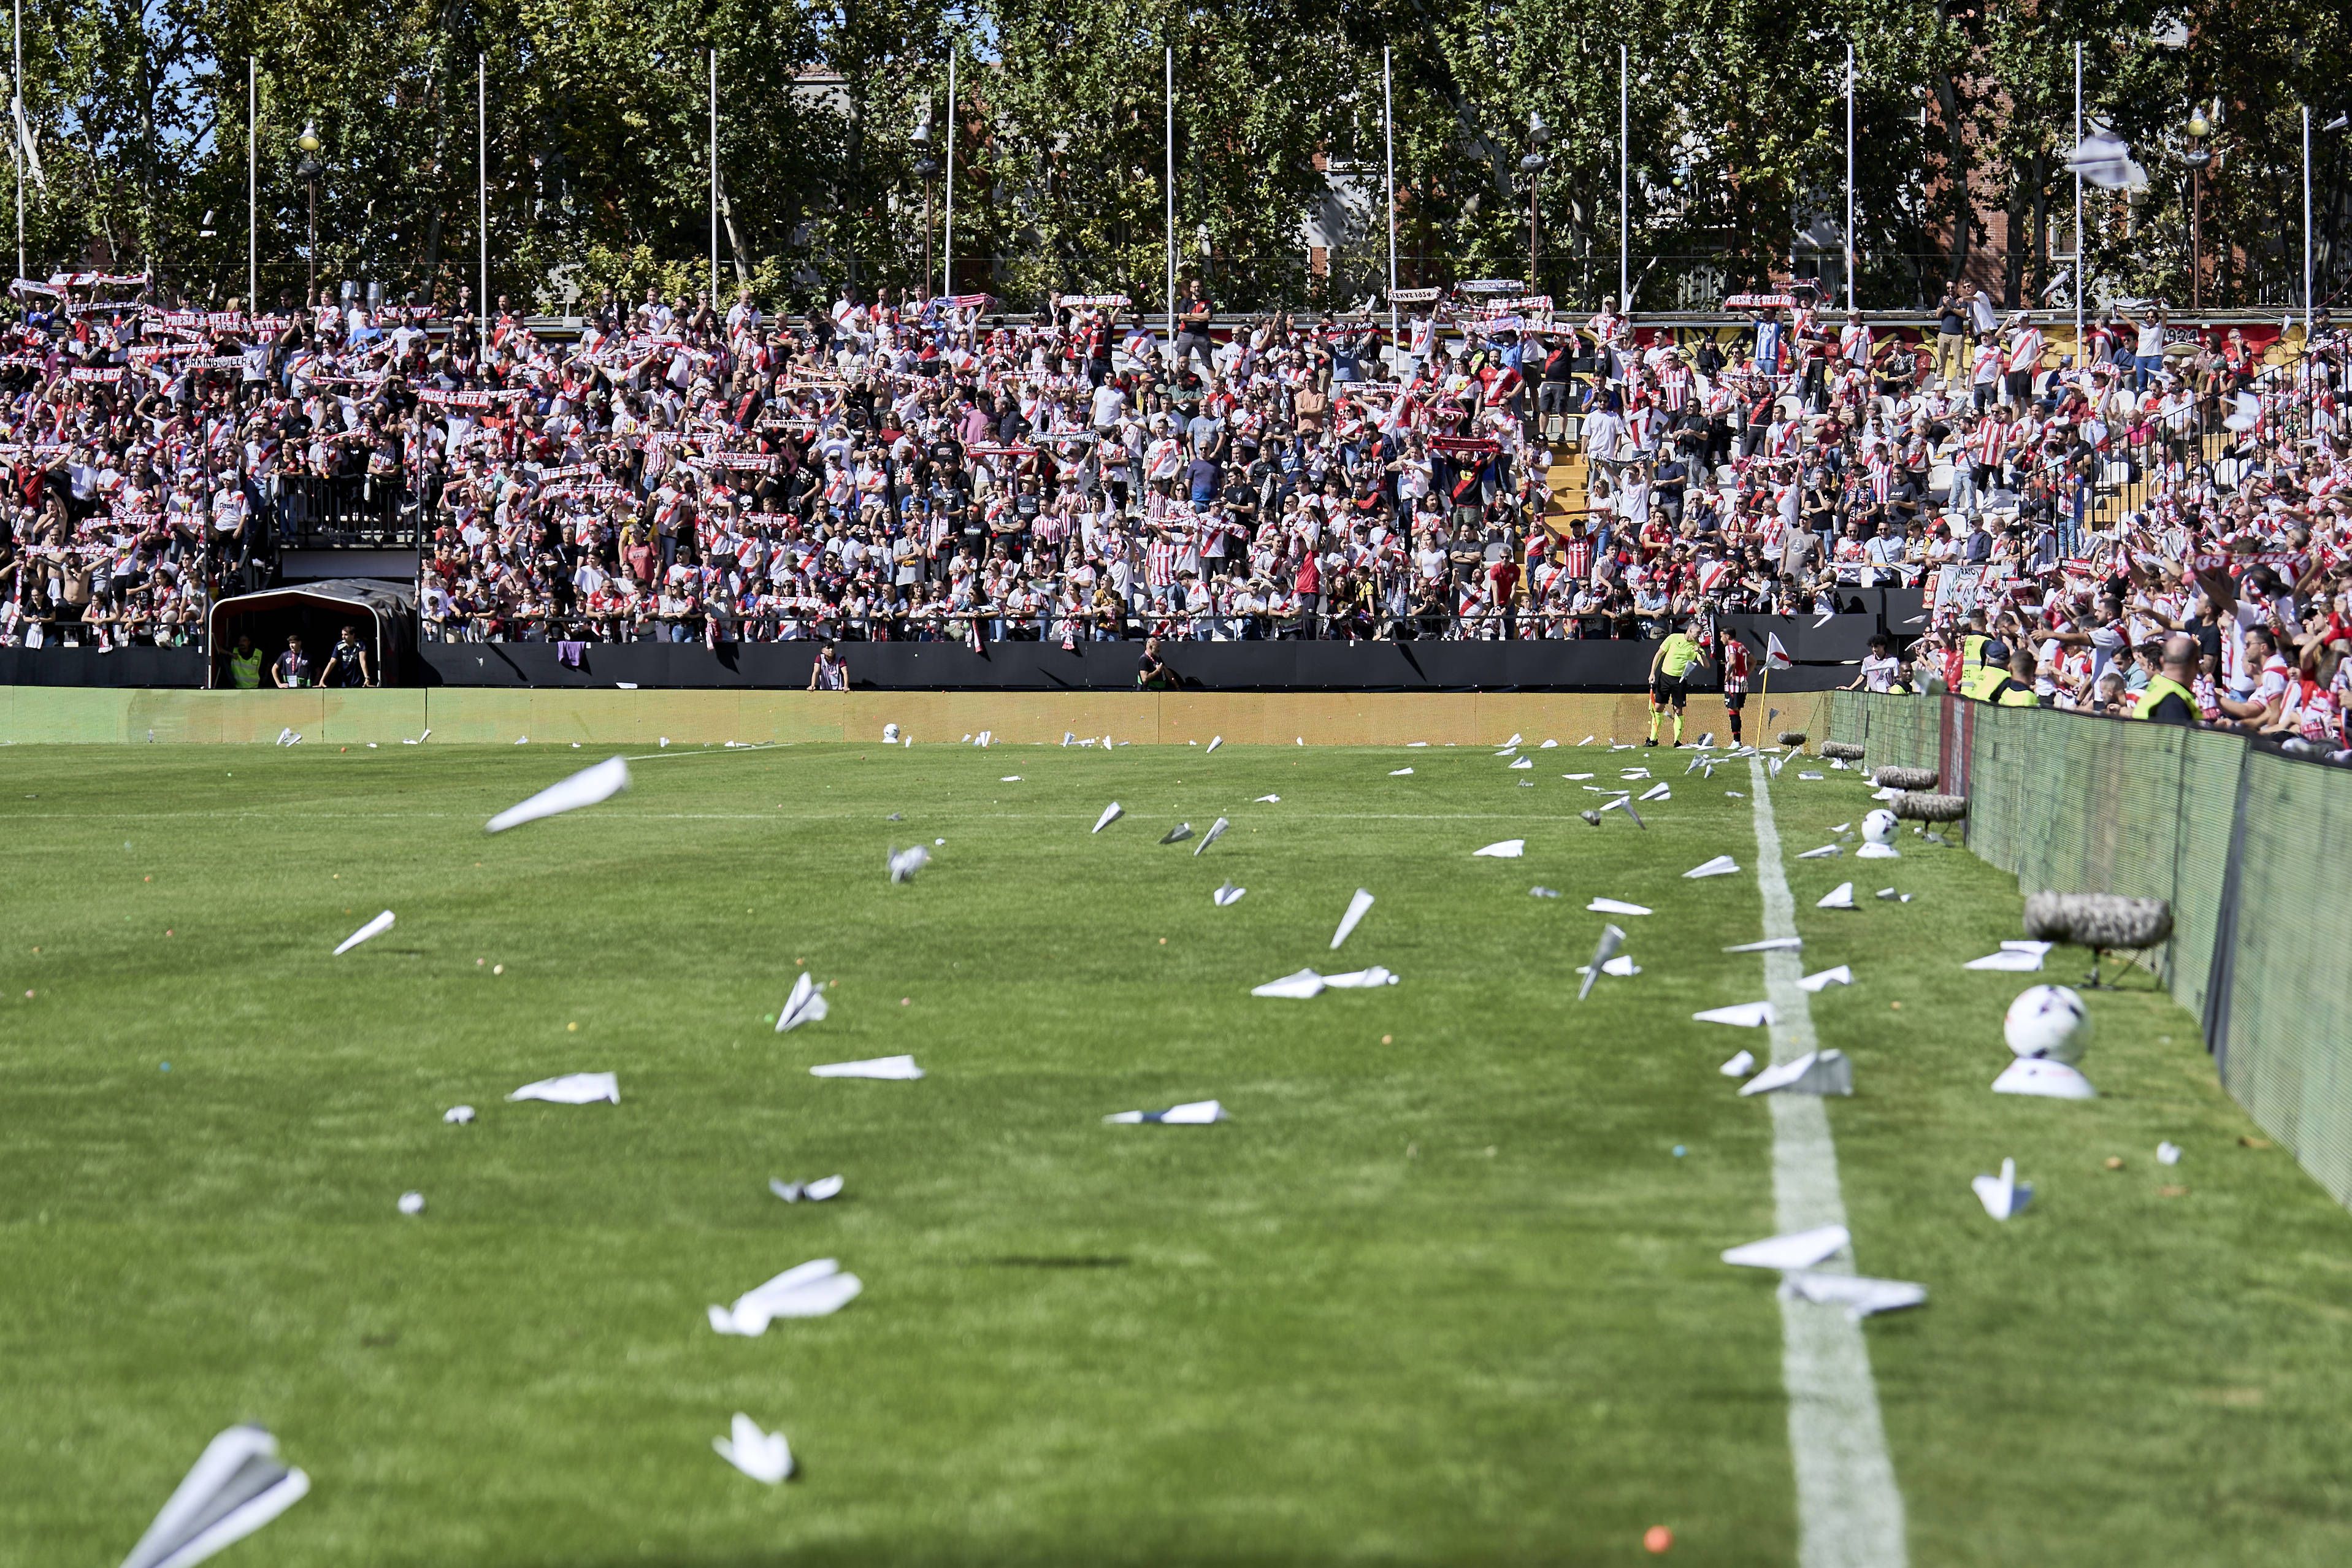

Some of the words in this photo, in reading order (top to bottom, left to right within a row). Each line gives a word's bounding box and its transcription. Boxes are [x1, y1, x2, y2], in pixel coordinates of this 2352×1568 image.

[165, 313, 194, 326] PRESA
[209, 312, 230, 324] VETE
[251, 320, 275, 331] VETE
[419, 389, 446, 402] PRESA
[458, 393, 478, 404] VETE
[478, 393, 489, 406] YA
